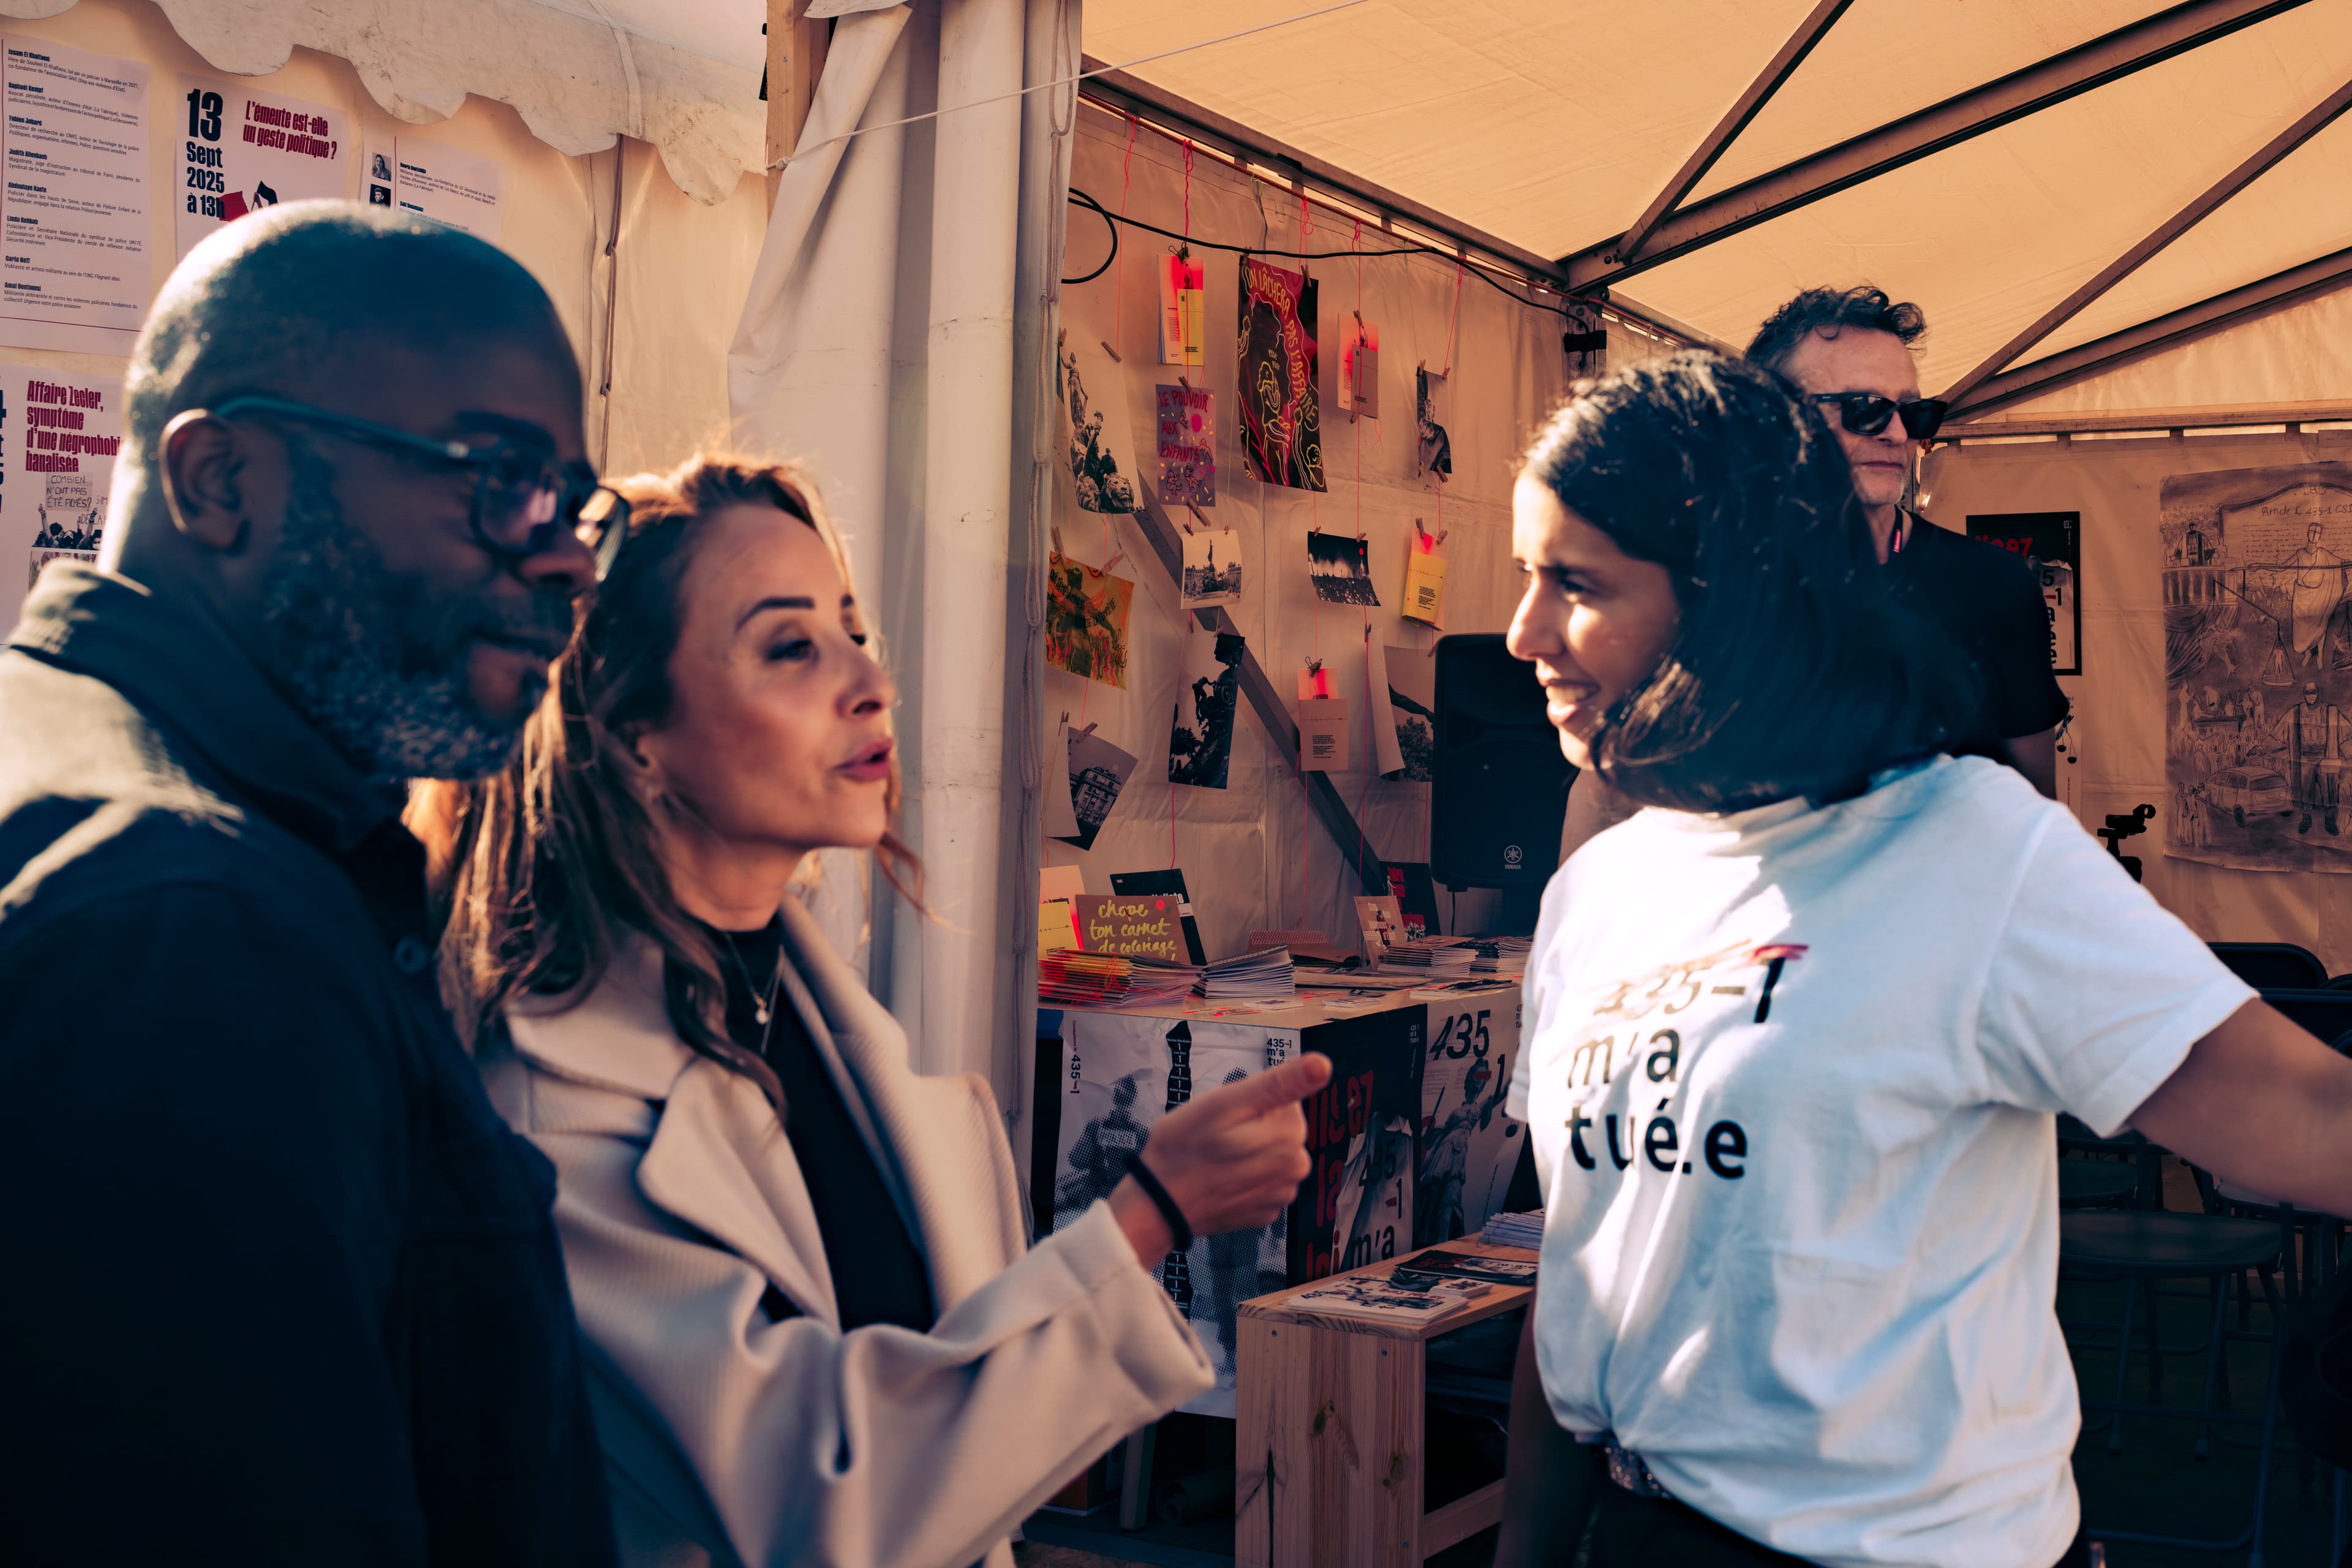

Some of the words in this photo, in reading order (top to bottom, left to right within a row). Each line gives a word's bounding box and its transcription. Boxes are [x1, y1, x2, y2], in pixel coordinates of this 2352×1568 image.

[9, 64, 37, 72] co-fondateur
[187, 88, 223, 141] 13
[246, 100, 291, 129] L'émeute
[292, 113, 328, 137] est-elle
[186, 141, 222, 168] Sept
[243, 124, 256, 143] un
[257, 127, 285, 149] geste
[286, 132, 329, 159] politique
[331, 141, 337, 159] ?
[187, 167, 224, 193] 2025
[187, 192, 197, 213] à
[200, 194, 225, 219] 13h
[1245, 266, 1257, 288] ON
[1259, 267, 1291, 318] LÂCHERA
[1284, 319, 1298, 348] PAS
[27, 380, 67, 405] Affaire
[69, 386, 104, 412] Zecler,
[1158, 392, 1169, 407] LE
[1171, 390, 1208, 412] POUVOIR
[27, 406, 84, 430] symptôme
[1162, 421, 1178, 434] AUX
[27, 428, 57, 450] d'une
[59, 432, 122, 456] négrophobi
[1160, 441, 1200, 462] ENFANTS
[26, 450, 78, 472] banalisée
[51, 475, 85, 484] COMBIEN
[47, 496, 62, 508] ÉTÉ
[2261, 505, 2290, 516] Article
[1090, 919, 1117, 940] ton
[1121, 918, 1171, 937] carnet
[1099, 940, 1115, 952] de
[1120, 938, 1176, 957] coloriage
[1429, 1009, 1491, 1061] 435
[1267, 1048, 1284, 1057] m'a
[1567, 1028, 1679, 1089] m'a
[1317, 1153, 1343, 1228] la
[1351, 1225, 1395, 1270] m'a
